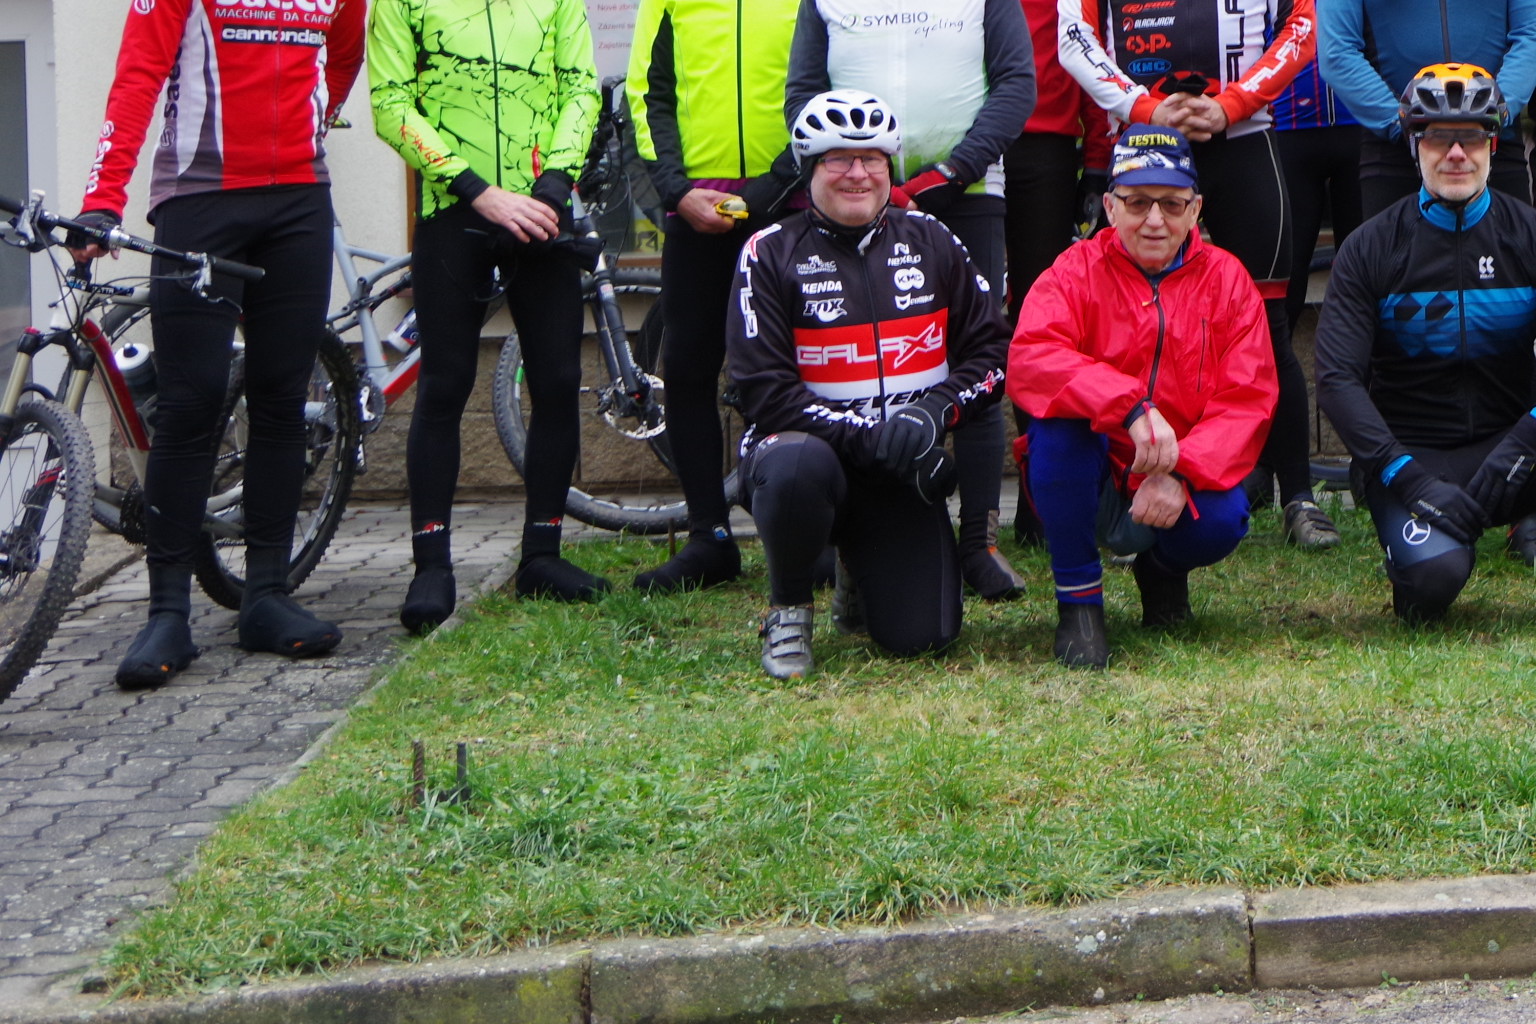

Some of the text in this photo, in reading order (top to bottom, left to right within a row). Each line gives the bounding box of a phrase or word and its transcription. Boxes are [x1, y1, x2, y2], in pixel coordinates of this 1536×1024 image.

[214, 8, 276, 21] MACCHINE
[283, 10, 300, 22] DA
[863, 12, 929, 26] SYMBIO
[1128, 133, 1179, 147] FESTINA
[802, 280, 843, 295] KENDA
[803, 297, 846, 317] FOX
[796, 321, 944, 370] GALAXY
